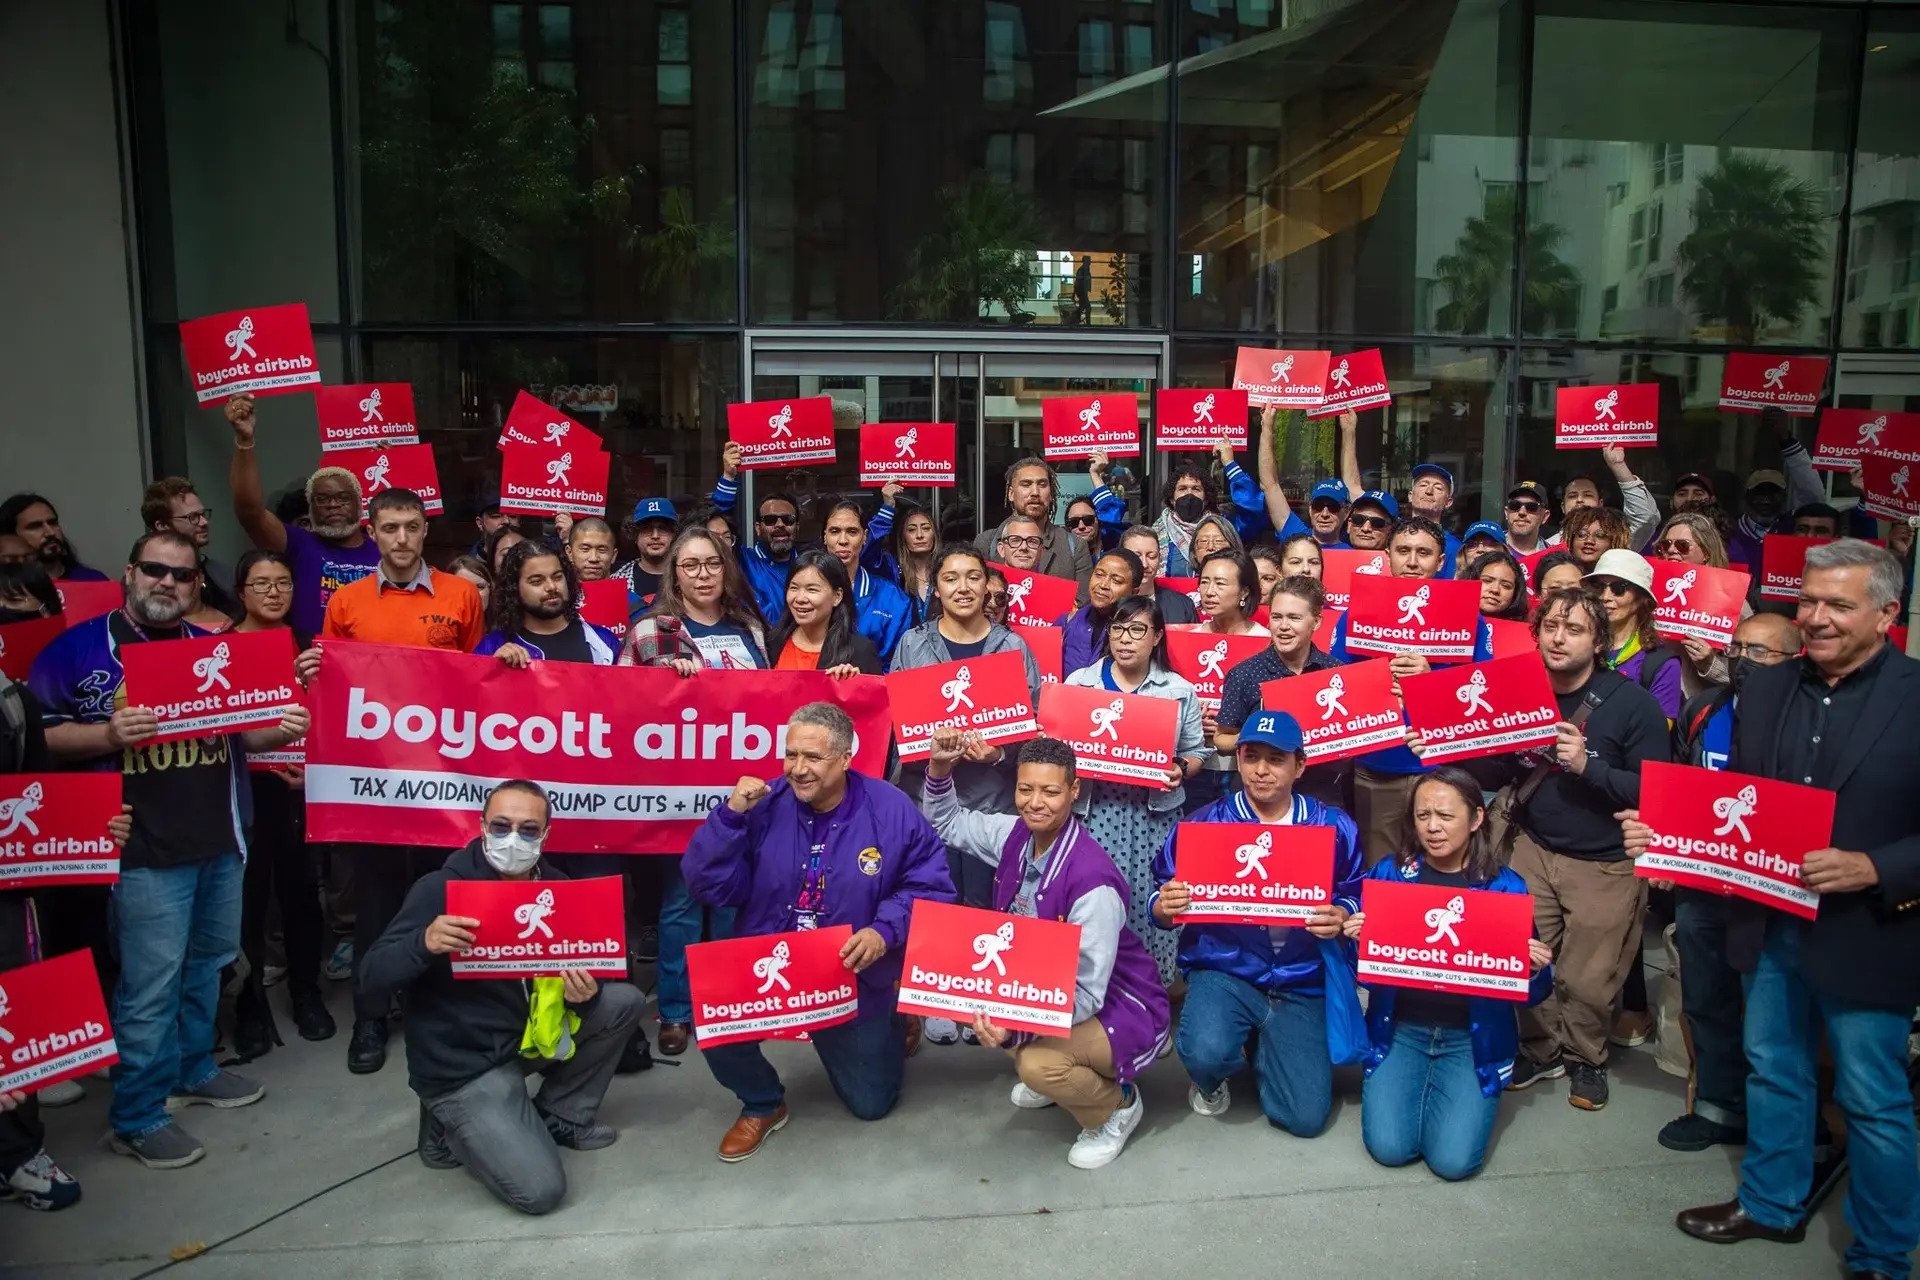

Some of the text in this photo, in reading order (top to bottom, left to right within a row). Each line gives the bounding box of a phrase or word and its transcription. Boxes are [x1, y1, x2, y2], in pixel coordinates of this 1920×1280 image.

[196, 355, 312, 385] boycott airbnb
[1238, 381, 1322, 395] boycott airbnb
[1322, 382, 1385, 404] ycott airbnb
[1727, 386, 1816, 402] boycott airbnb
[326, 422, 415, 439] boycott airbnb
[1162, 424, 1245, 437] boycott airbnb
[1561, 420, 1654, 434] boycott airbnb
[736, 436, 831, 454] boycott airbnb
[1049, 430, 1136, 445] boycott airbnb
[865, 459, 952, 472] boycott airbnb
[508, 483, 604, 503] boycott airbnb
[1371, 491, 1385, 501] 21
[1867, 490, 1904, 509] boycott
[648, 501, 661, 512] 21
[1767, 573, 1802, 586] boyc
[1679, 609, 1733, 629] airbnb
[1353, 621, 1471, 641] boycott airbnb
[1687, 627, 1709, 637] HOUSING
[1709, 632, 1725, 641] CRISIS
[226, 685, 293, 707] airbnb
[157, 710, 271, 732] AVOIDANCE TRUMP CUTS HOUSING
[345, 687, 613, 760] boycott
[971, 702, 1029, 725] airbnb
[1420, 706, 1554, 740] boycott airbnb
[988, 726, 1011, 736] HOUSING
[1012, 723, 1028, 731] CRISIS
[1256, 717, 1275, 734] 21
[1302, 709, 1399, 743] ycott airbnb
[1326, 730, 1399, 751] TRUMP CUTS HOUSING CRISIS
[1438, 742, 1467, 752] AVOIDANCE
[1472, 738, 1492, 747] TRUMP
[1512, 731, 1537, 740] HOUSING
[1536, 728, 1555, 736] CRISIS
[1111, 744, 1168, 765] airbnb
[1122, 767, 1145, 775] HOUSING
[1145, 770, 1162, 778] CRISIS
[350, 776, 388, 798] TAX
[547, 790, 606, 813] RUMP
[613, 794, 668, 814] CUTS
[33, 836, 114, 855] airbnb
[1649, 831, 1801, 879] boycott airbn
[1647, 856, 1809, 901] TAX AVOIDANCE TRUMP CUTS HOUSING CRISIS
[1183, 881, 1327, 901] boycott airbnb
[1194, 904, 1225, 912] AVOIDANCE
[1275, 907, 1301, 915] HOUSING
[549, 938, 620, 955] airbnb
[1368, 940, 1524, 972] boycott airbnb
[911, 965, 1068, 1006] boycott airbnb
[1380, 965, 1413, 975] AVOIDANCE
[1421, 970, 1443, 979] TRUMP
[1444, 973, 1461, 981] CUTS
[1468, 977, 1496, 985] HOUSING
[1497, 980, 1518, 988] CRISIS
[702, 985, 852, 1019] boycott airbnb
[909, 993, 1061, 1023] TAX AVOIDANCE TRUMP CUTS HOUSING CRISIS
[707, 1027, 718, 1035] TAX
[719, 1022, 752, 1033] AVOIDANCE
[760, 1018, 782, 1027] TRUMP
[782, 1015, 798, 1024] CUTS
[804, 1011, 830, 1020] HOUSING
[11, 1020, 104, 1064] airbnb
[8, 1047, 103, 1085] CUTS HOUSING CRISIS
